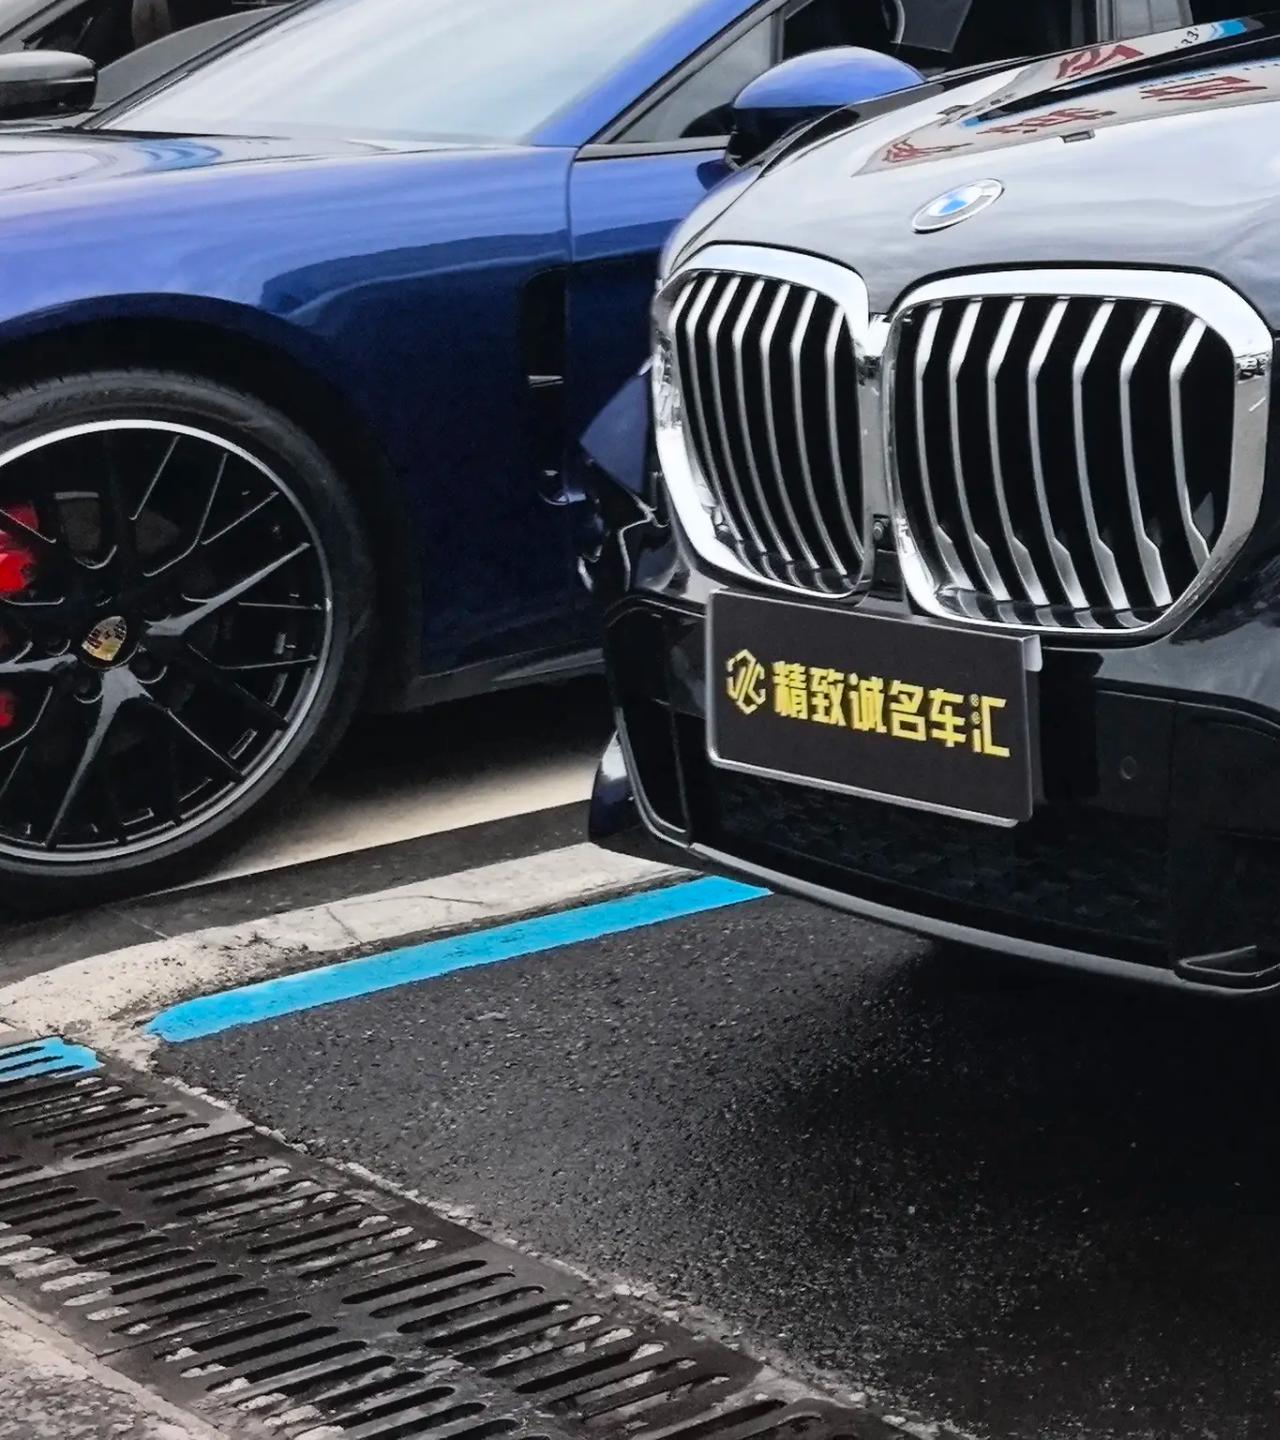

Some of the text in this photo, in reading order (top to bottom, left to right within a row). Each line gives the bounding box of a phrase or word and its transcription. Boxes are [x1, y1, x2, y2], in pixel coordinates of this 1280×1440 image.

[771, 659, 1011, 758] 精致诚名车汇
